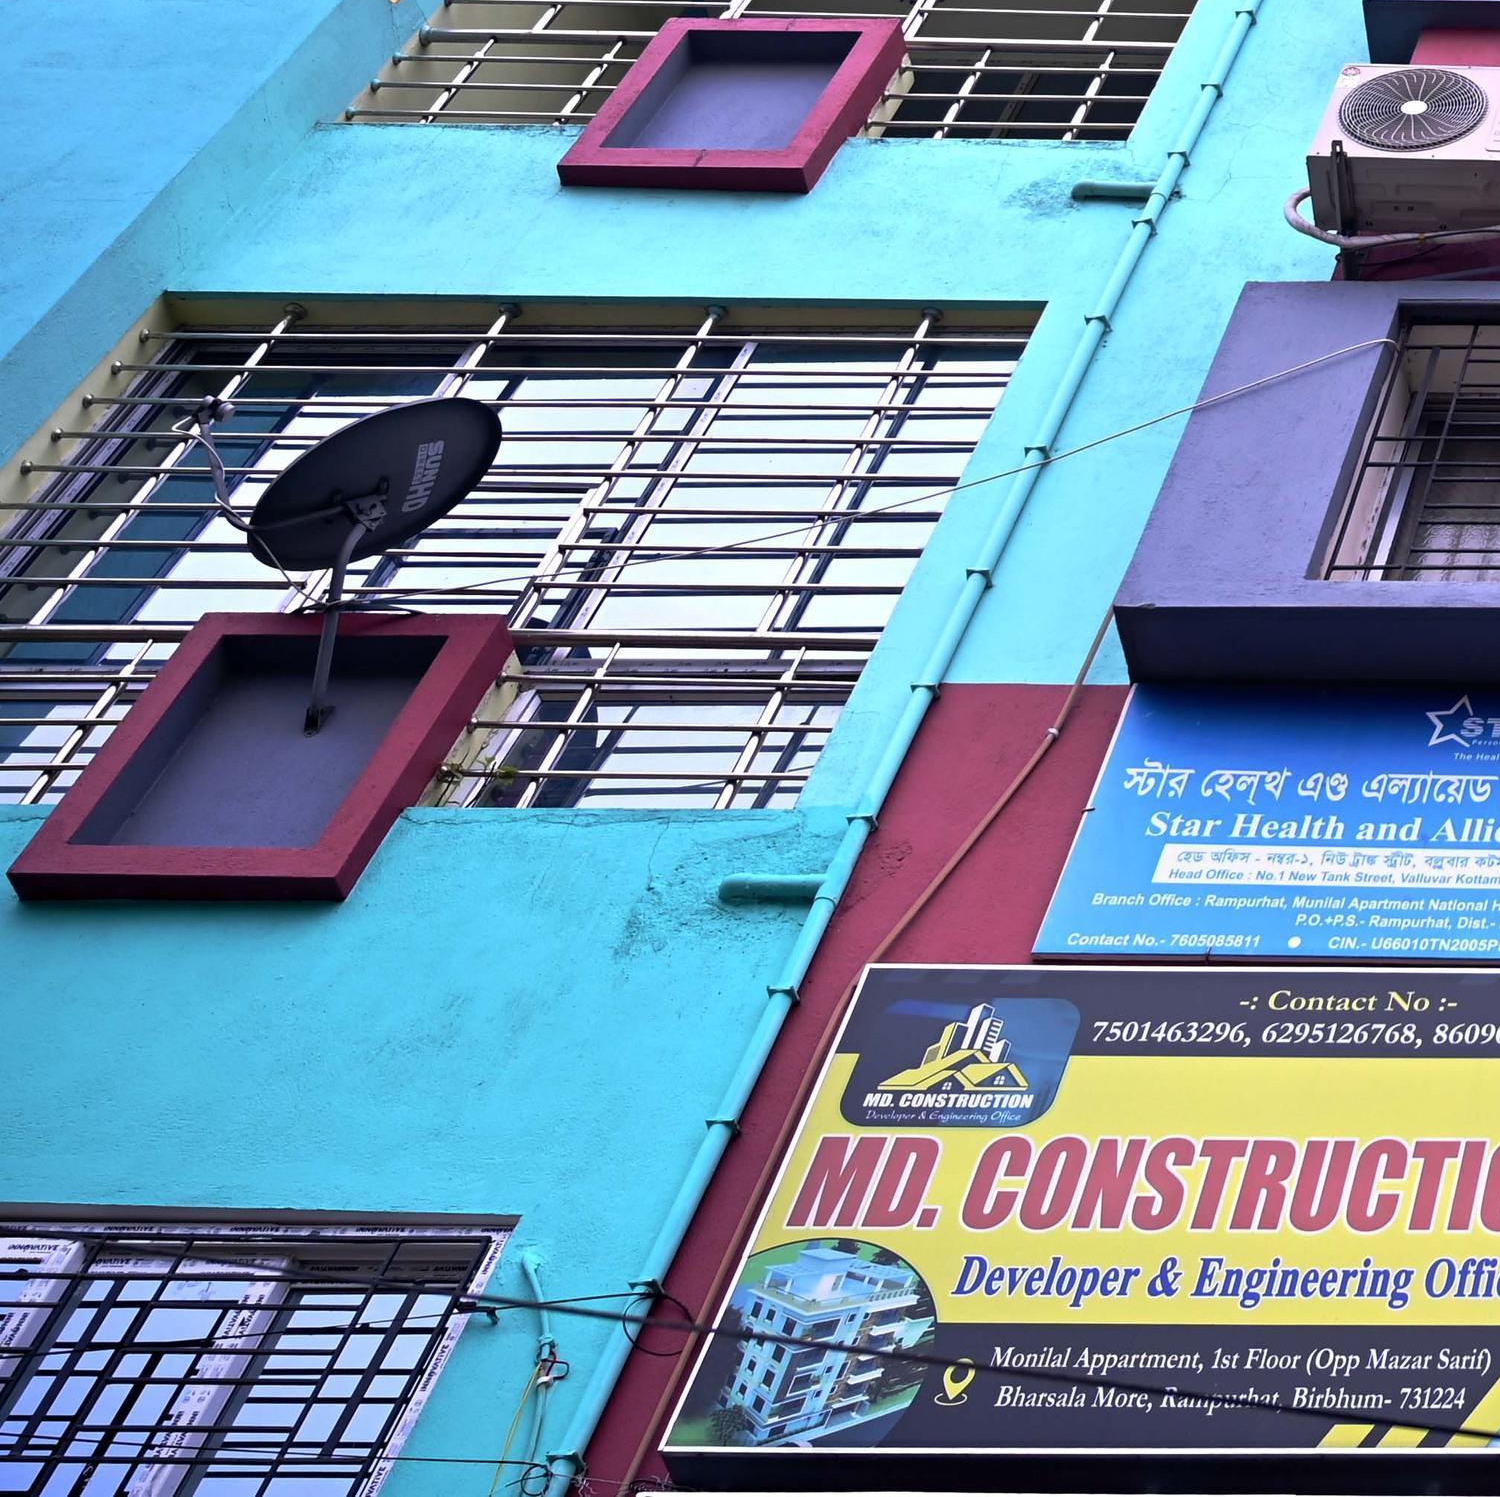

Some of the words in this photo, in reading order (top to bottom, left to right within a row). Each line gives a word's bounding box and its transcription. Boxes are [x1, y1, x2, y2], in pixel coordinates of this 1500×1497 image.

[1454, 752, 1472, 760] The
[1123, 758, 1195, 799] স্টার
[1144, 811, 1222, 838] Star
[1230, 813, 1344, 840] Health
[1356, 817, 1422, 842] and
[1169, 869, 1201, 880] Head
[1205, 869, 1244, 880] Office
[1289, 871, 1317, 882] New
[1322, 871, 1350, 883] Tank
[1354, 872, 1395, 885] Street,
[1401, 872, 1452, 884] Valluvar
[1456, 874, 1500, 885] Kottam
[1091, 892, 1145, 906] Branch
[1148, 894, 1191, 907] Office
[1204, 895, 1287, 911] Rampurhat,
[1348, 896, 1425, 912] Apartment
[1428, 897, 1487, 911] National
[1369, 915, 1453, 931] Rampurhat,
[1067, 933, 1131, 946] Contact
[1170, 934, 1261, 948] 7605085811
[1268, 990, 1376, 1012] Contact
[1387, 991, 1431, 1012] No
[1092, 1020, 1252, 1046] 7501463296,
[1262, 1021, 1422, 1047] 6295126768,
[863, 1093, 894, 1107] MD.
[899, 1093, 1034, 1108] CONSTRUCTION
[865, 1110, 916, 1123] Developer
[918, 1112, 926, 1120] &
[929, 1111, 988, 1123] Engineering
[990, 1111, 1021, 1123] Office
[784, 1135, 940, 1233] MD.
[952, 1255, 1141, 1306] Developer
[1148, 1258, 1180, 1299] &
[1190, 1256, 1415, 1309] Engineering
[990, 1347, 1070, 1369] Monilal
[1073, 1348, 1205, 1375] Appartment,
[1211, 1348, 1239, 1370] 1st
[1244, 1348, 1300, 1370] Floor
[1305, 1348, 1361, 1376] (Opp
[1365, 1350, 1431, 1371] Mazar
[1436, 1349, 1493, 1372] Sarif)
[993, 1385, 1085, 1409] Bharsala
[1091, 1386, 1153, 1412] More,
[1292, 1387, 1392, 1410] Birbhum-
[1399, 1387, 1467, 1410] 731224
